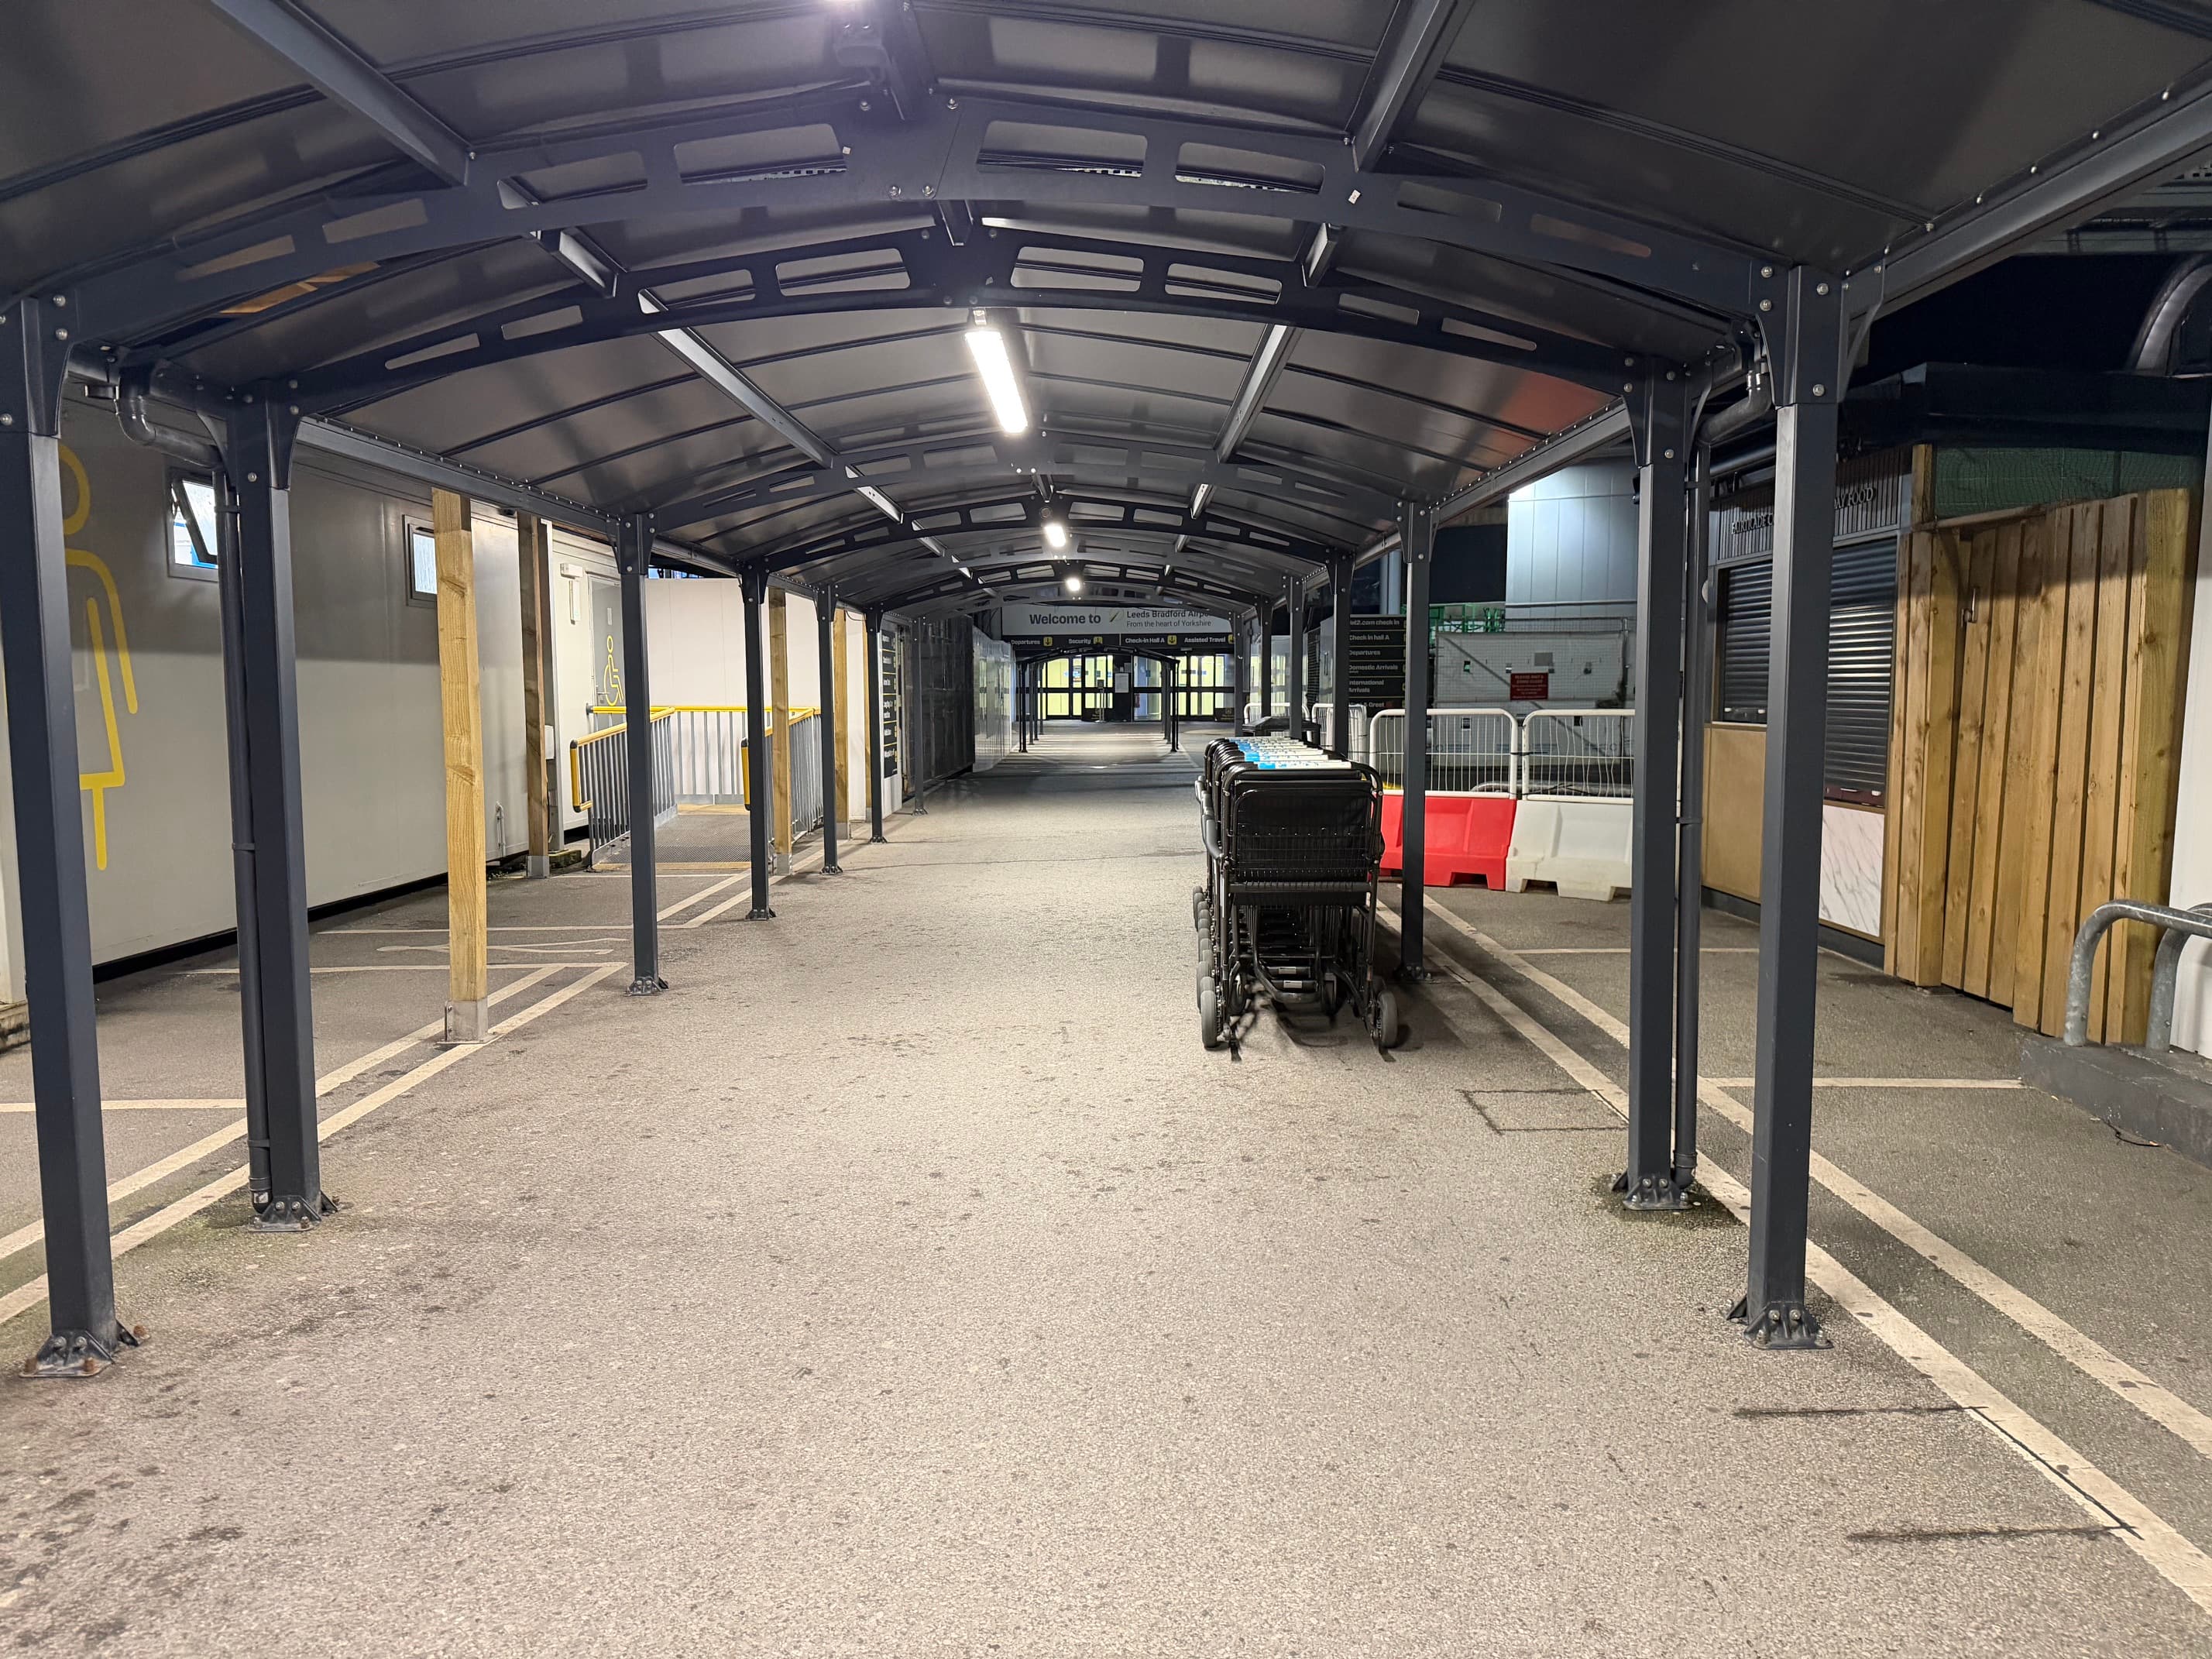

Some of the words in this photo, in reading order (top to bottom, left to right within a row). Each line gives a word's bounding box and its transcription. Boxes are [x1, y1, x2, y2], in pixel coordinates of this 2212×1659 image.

[1847, 487, 1874, 507] FOOD
[1731, 514, 1767, 534] FAIRTRADE
[1029, 613, 1086, 625] Welcome
[1088, 613, 1101, 624] to
